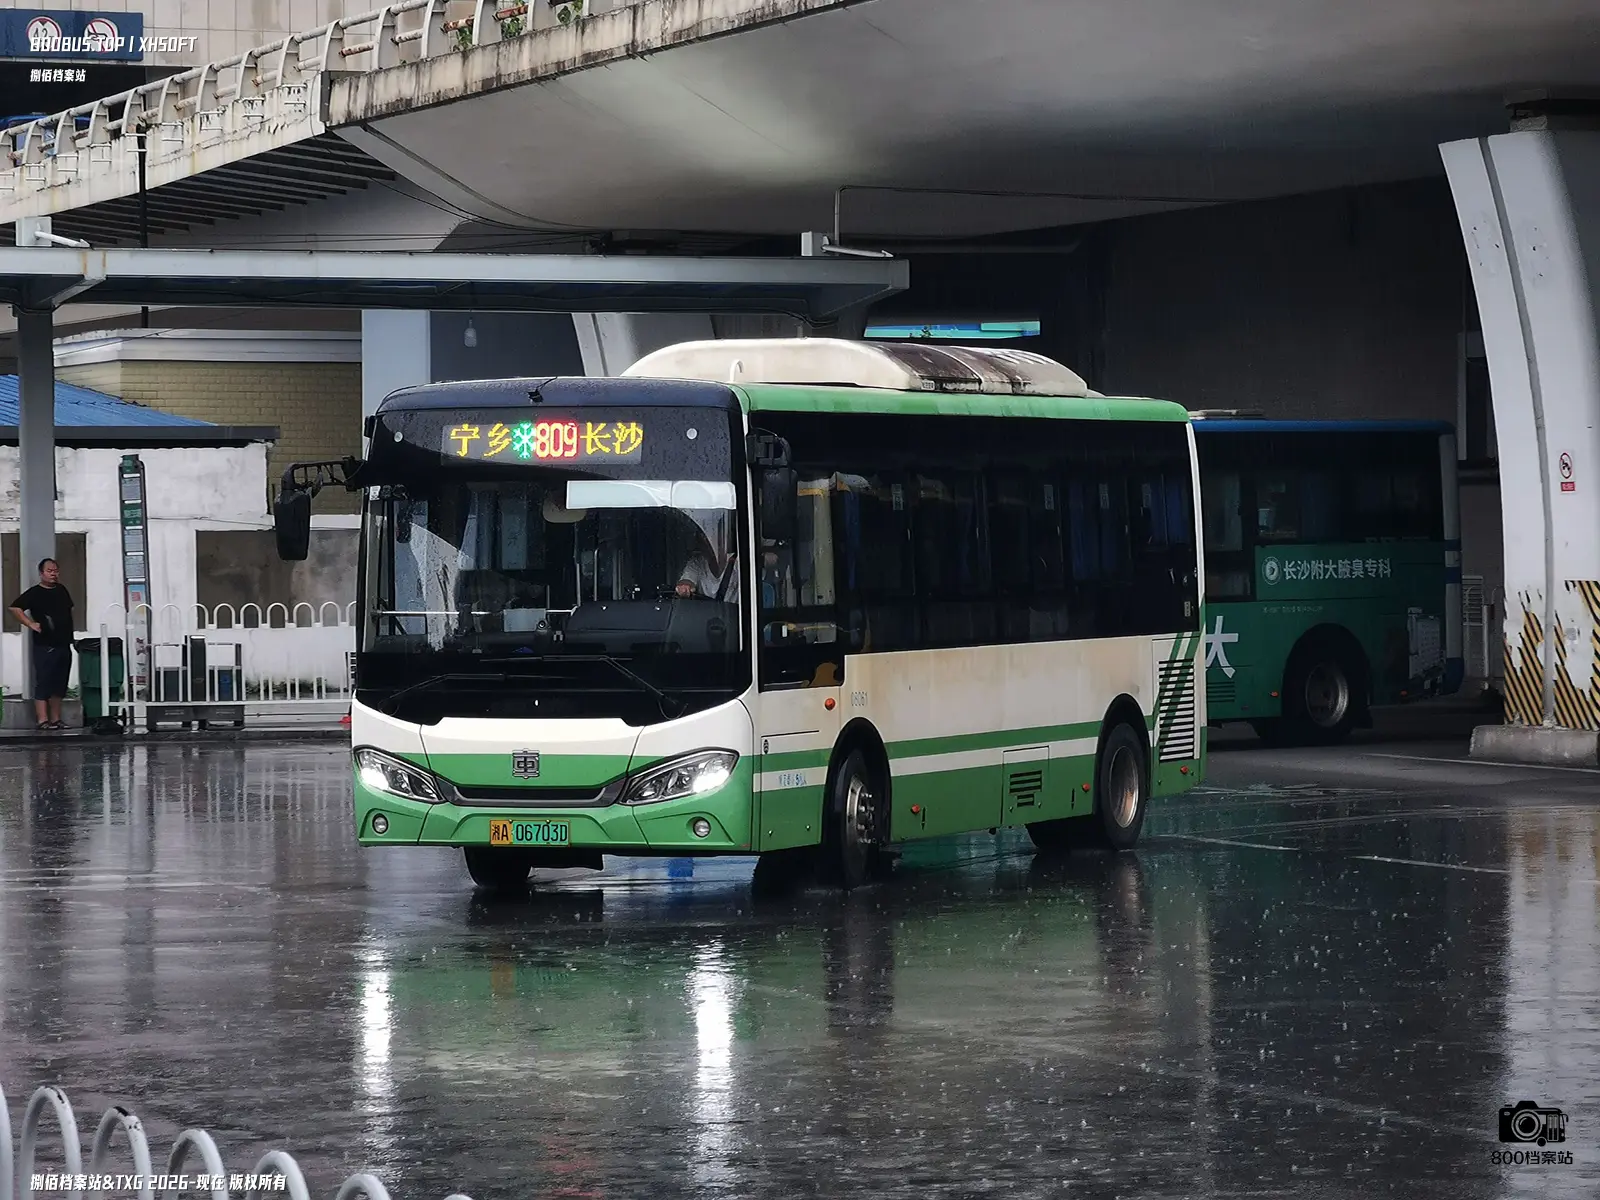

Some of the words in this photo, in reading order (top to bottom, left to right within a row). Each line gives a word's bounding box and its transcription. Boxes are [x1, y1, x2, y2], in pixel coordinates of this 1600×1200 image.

[450, 421, 512, 458] 宁乡
[535, 422, 578, 458] 809
[579, 421, 643, 456] 长沙
